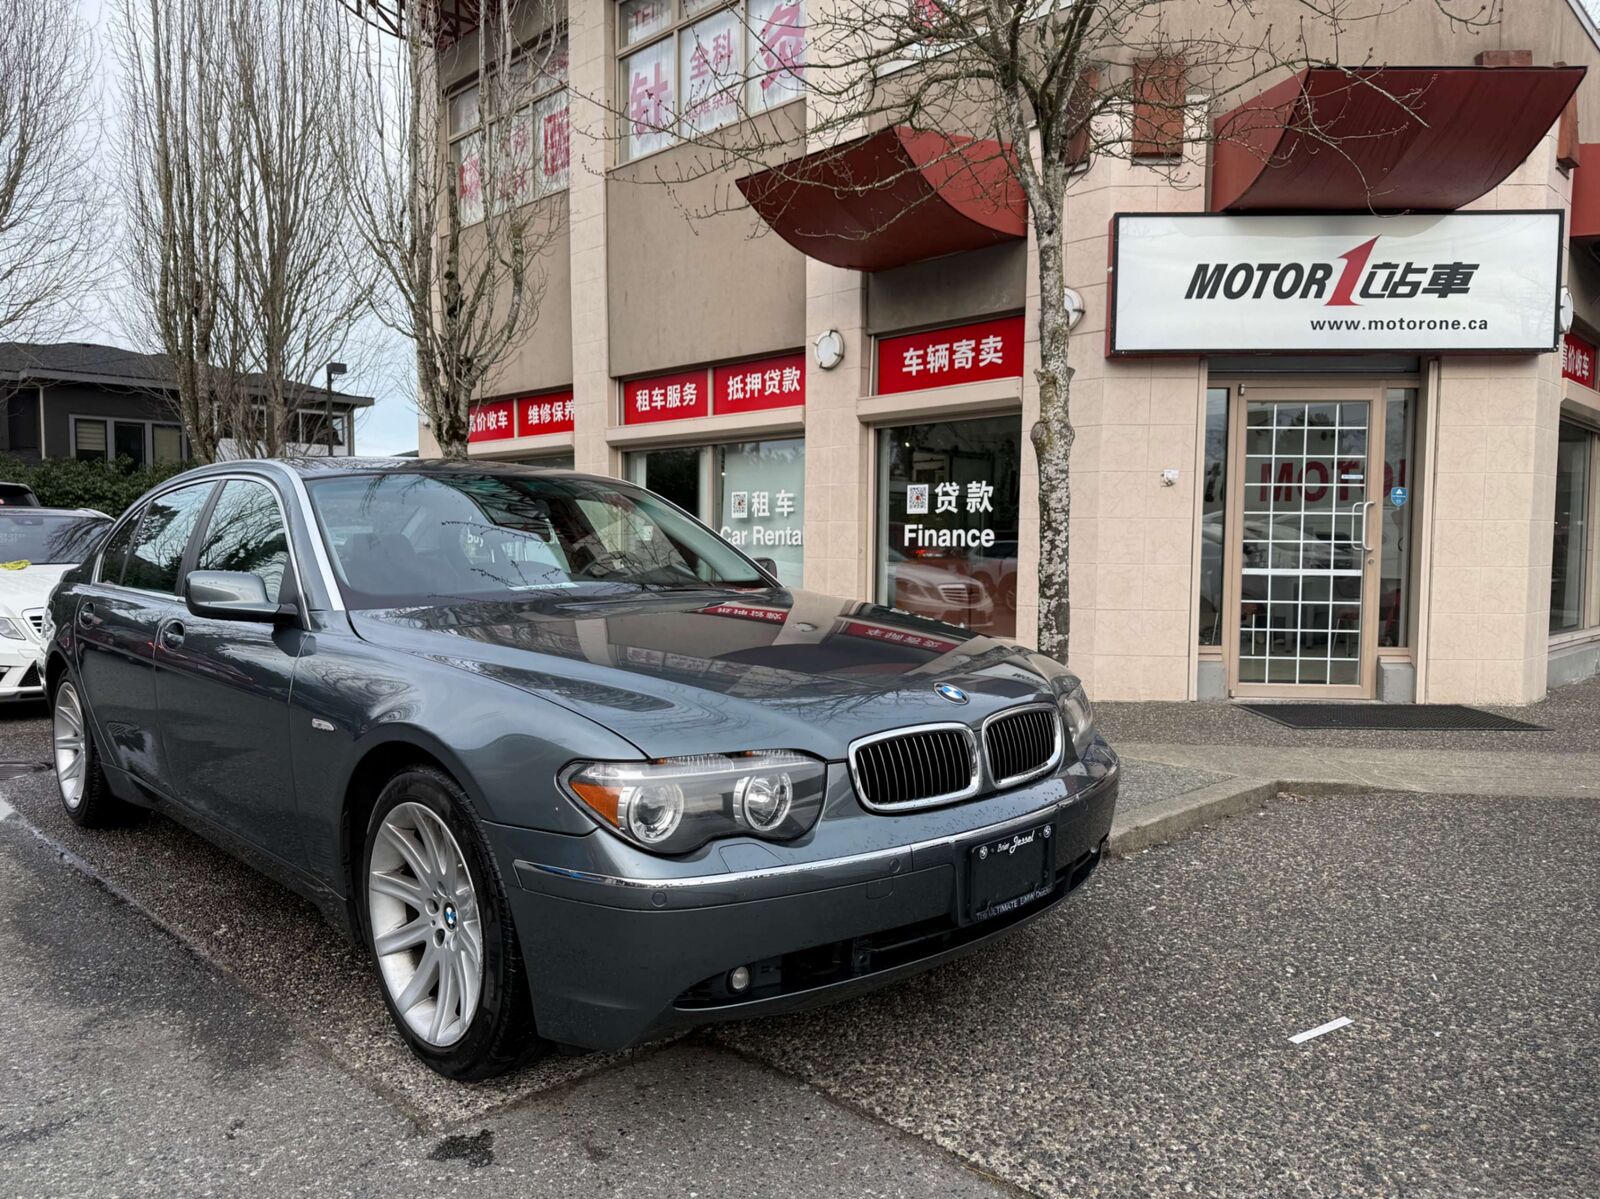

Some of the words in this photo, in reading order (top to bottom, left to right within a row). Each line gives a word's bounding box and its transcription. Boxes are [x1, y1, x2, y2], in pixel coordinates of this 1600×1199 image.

[689, 28, 734, 81] 全科
[631, 62, 669, 141] 针
[1184, 262, 1333, 300] MOTOR
[1310, 317, 1489, 331] www.motorone.ca
[902, 335, 1004, 376] 车辆寄卖
[636, 382, 698, 412] 租车服务
[727, 366, 801, 401] 抵押贷款
[528, 399, 575, 425] 维修保养
[1259, 459, 1406, 502] MOT
[751, 489, 795, 518] 租车
[934, 481, 994, 513] 贷款
[721, 527, 747, 546] Car
[753, 526, 802, 545] Renta
[904, 524, 995, 547] Finance
